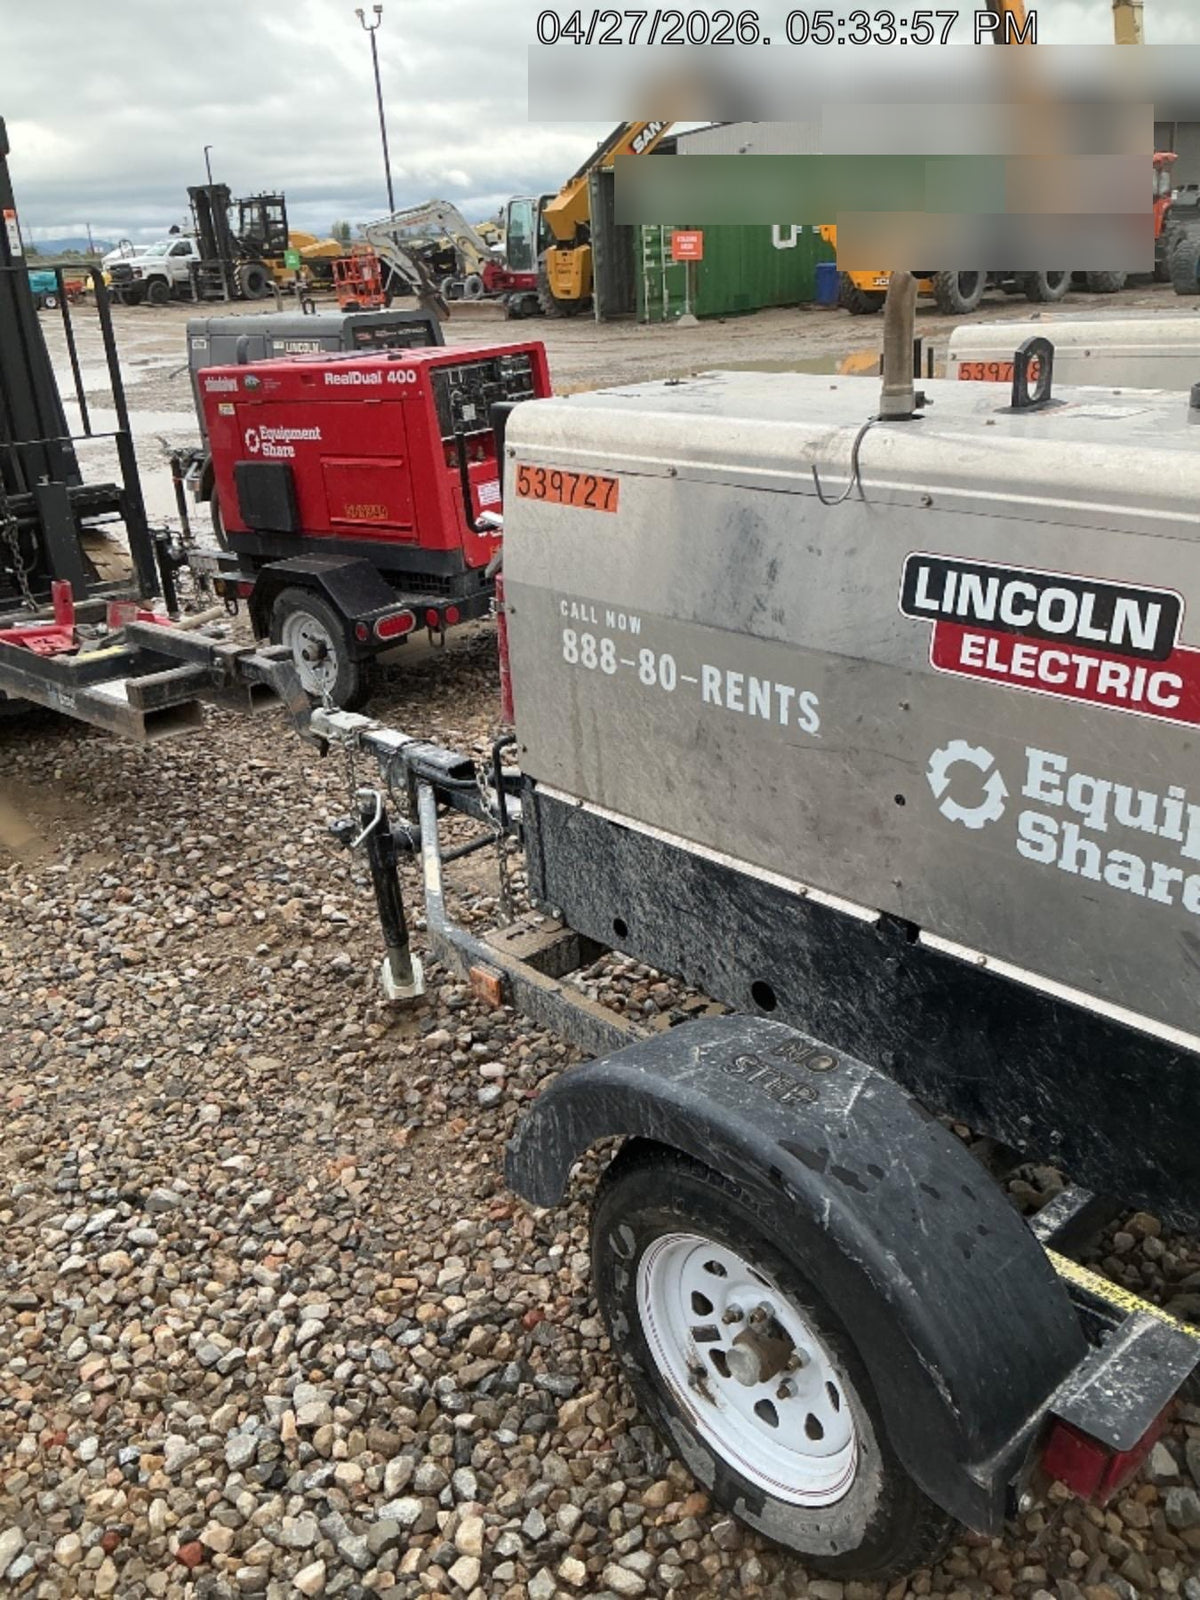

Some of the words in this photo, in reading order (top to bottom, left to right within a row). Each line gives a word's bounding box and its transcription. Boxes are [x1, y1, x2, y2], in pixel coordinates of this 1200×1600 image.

[632, 121, 667, 154] SAN
[324, 370, 383, 385] RealDual
[386, 369, 417, 384] 400
[960, 361, 1042, 382] 53978
[259, 425, 322, 443] Equipment
[261, 442, 296, 458] Share
[518, 465, 617, 509] 539727
[560, 599, 598, 625] CALL
[605, 609, 641, 635] NOW
[914, 565, 1163, 651] LINCOLN
[959, 632, 1184, 709] ELECTRIC
[771, 1038, 840, 1075] NO
[722, 1053, 820, 1105] STEP
